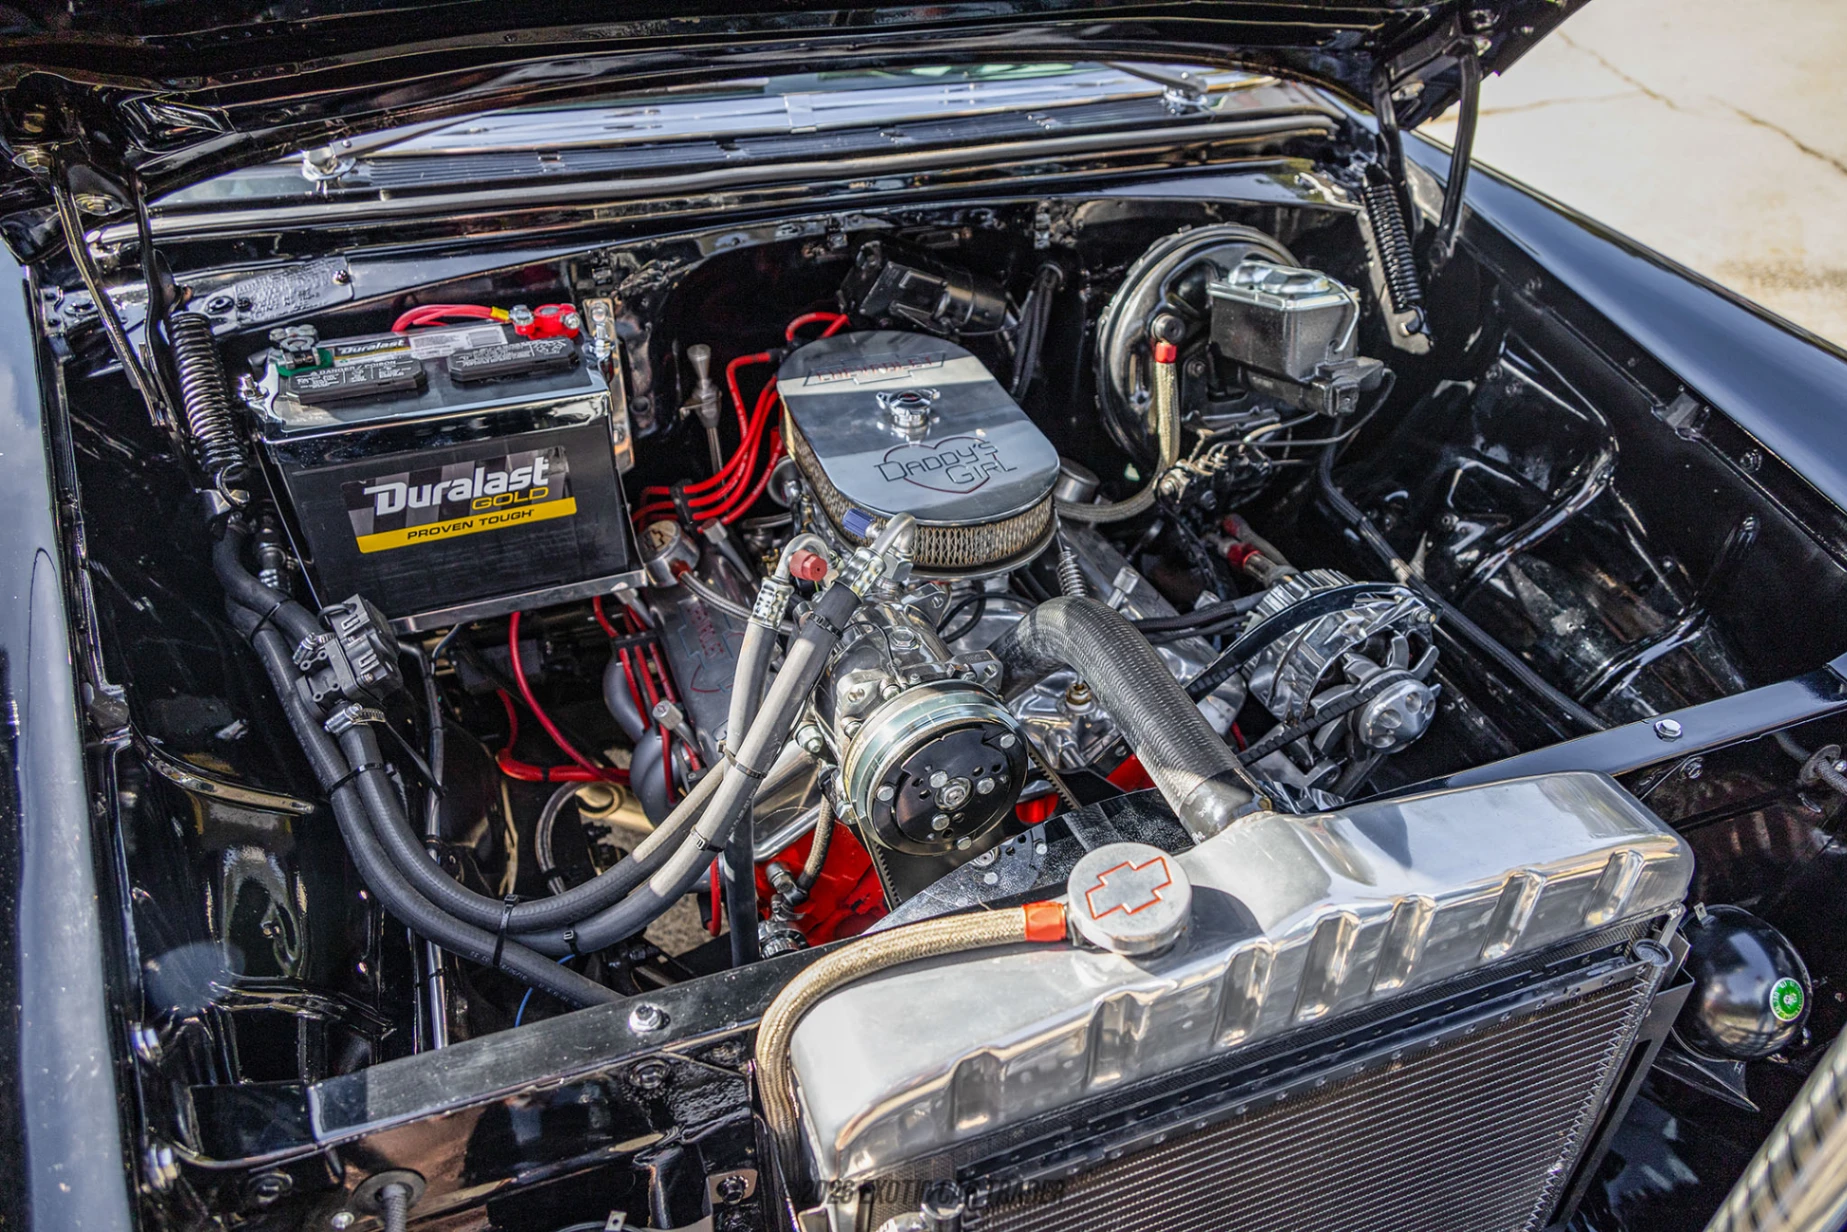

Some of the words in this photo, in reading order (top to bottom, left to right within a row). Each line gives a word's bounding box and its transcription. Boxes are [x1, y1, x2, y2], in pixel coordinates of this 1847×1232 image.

[338, 340, 405, 355] Duralast
[319, 365, 356, 376] DANGER
[873, 441, 998, 482] DADDY'S
[945, 460, 1018, 484] GIRL
[363, 456, 550, 516] Duralast
[471, 486, 549, 511] GOLD
[407, 520, 474, 540] PROVEN
